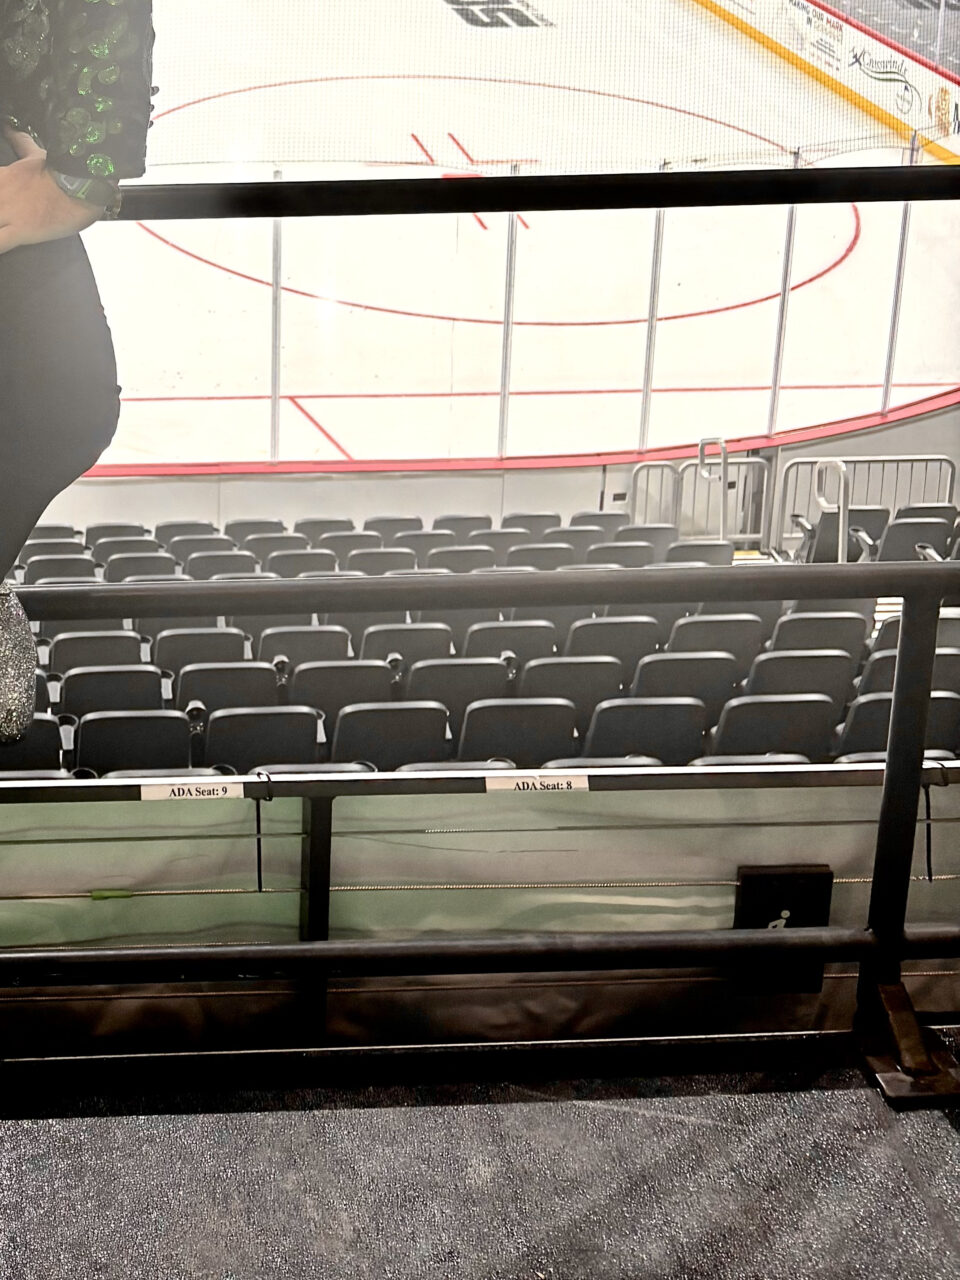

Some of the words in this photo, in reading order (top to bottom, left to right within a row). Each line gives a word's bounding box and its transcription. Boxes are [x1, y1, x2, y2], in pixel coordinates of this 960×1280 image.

[811, 7, 824, 24] OUR
[825, 16, 844, 33] MARK
[168, 787, 194, 799] ADA
[195, 786, 219, 798] Seat:
[221, 785, 228, 797] 9
[513, 781, 538, 792] ADA
[539, 780, 565, 792] Seat:
[566, 780, 573, 791] 8
